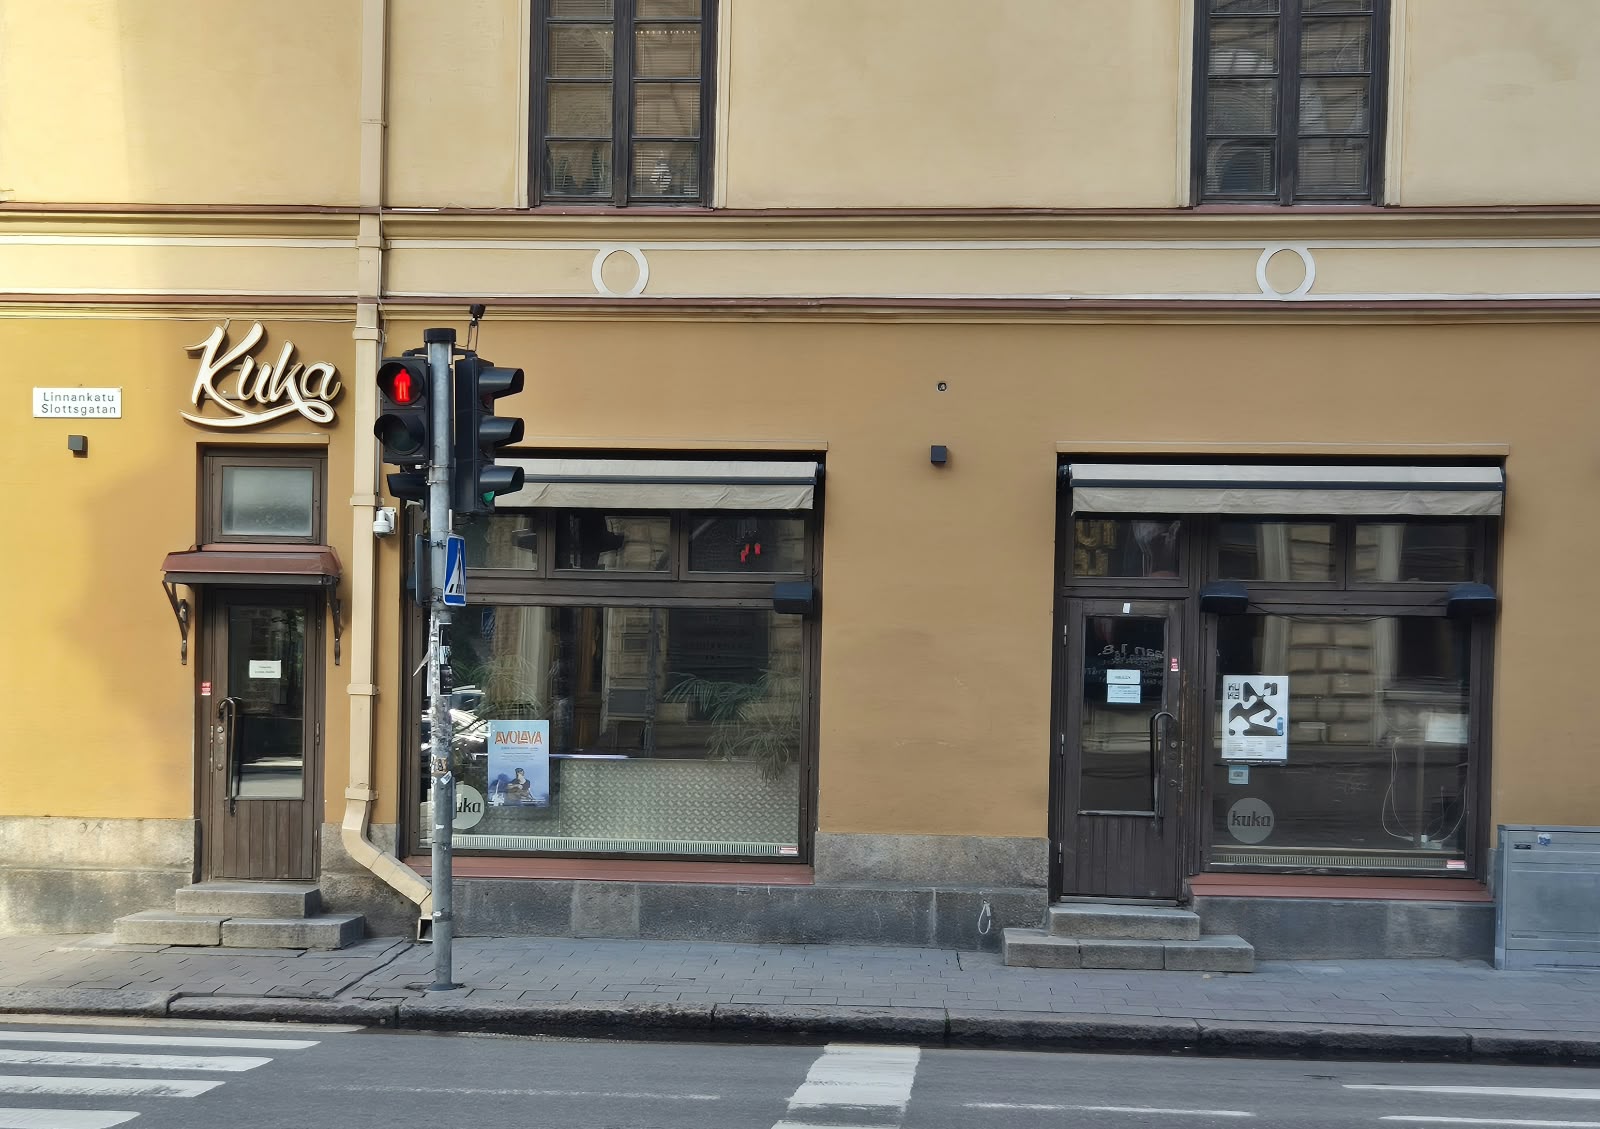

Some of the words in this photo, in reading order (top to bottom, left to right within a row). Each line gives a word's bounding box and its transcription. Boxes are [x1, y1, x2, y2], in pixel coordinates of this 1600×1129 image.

[179, 320, 342, 427] Kuka
[43, 391, 115, 402] Linnankatu
[41, 403, 117, 416] Slottsgatan
[494, 731, 543, 744] AVOLAVA
[456, 797, 481, 812] uka
[1231, 810, 1272, 827] kuka
